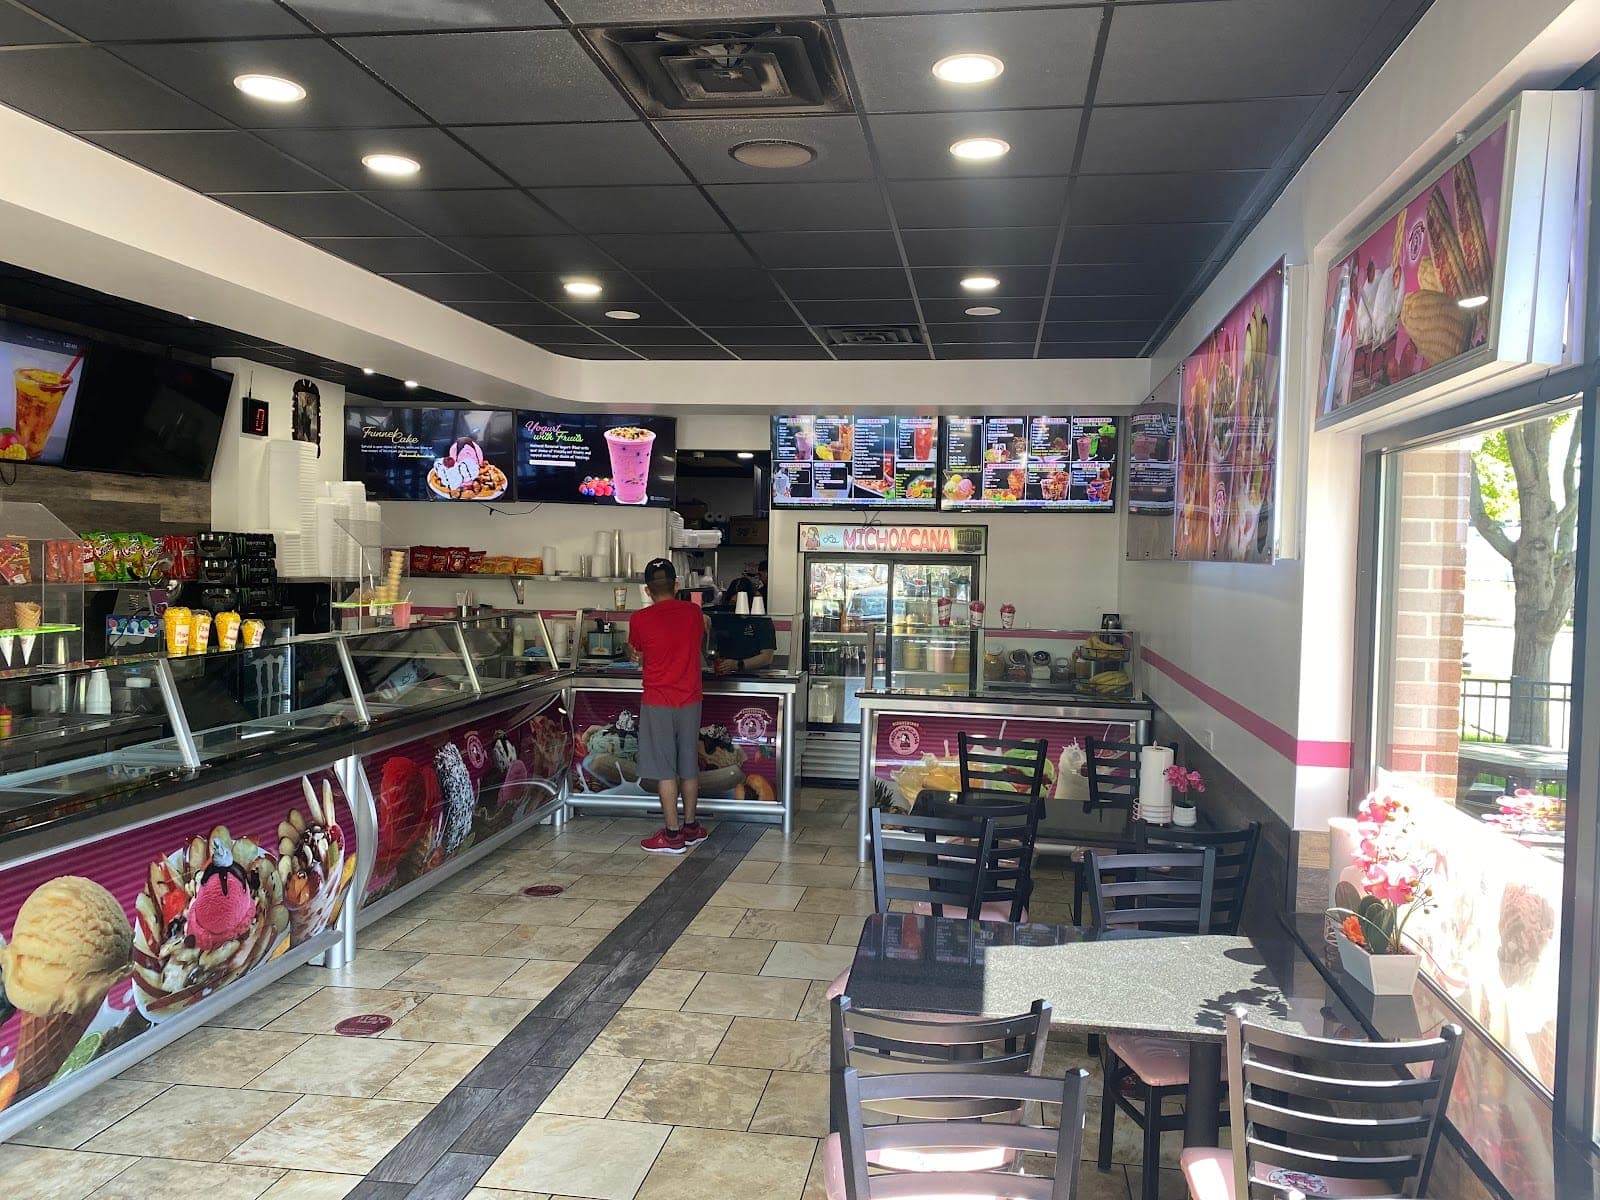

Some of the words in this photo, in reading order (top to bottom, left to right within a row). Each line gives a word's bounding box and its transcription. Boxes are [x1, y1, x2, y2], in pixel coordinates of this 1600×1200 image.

[362, 426, 399, 439] Funnel
[391, 431, 419, 444] Cake
[533, 432, 554, 441] with
[842, 527, 952, 552] MICHOACANA
